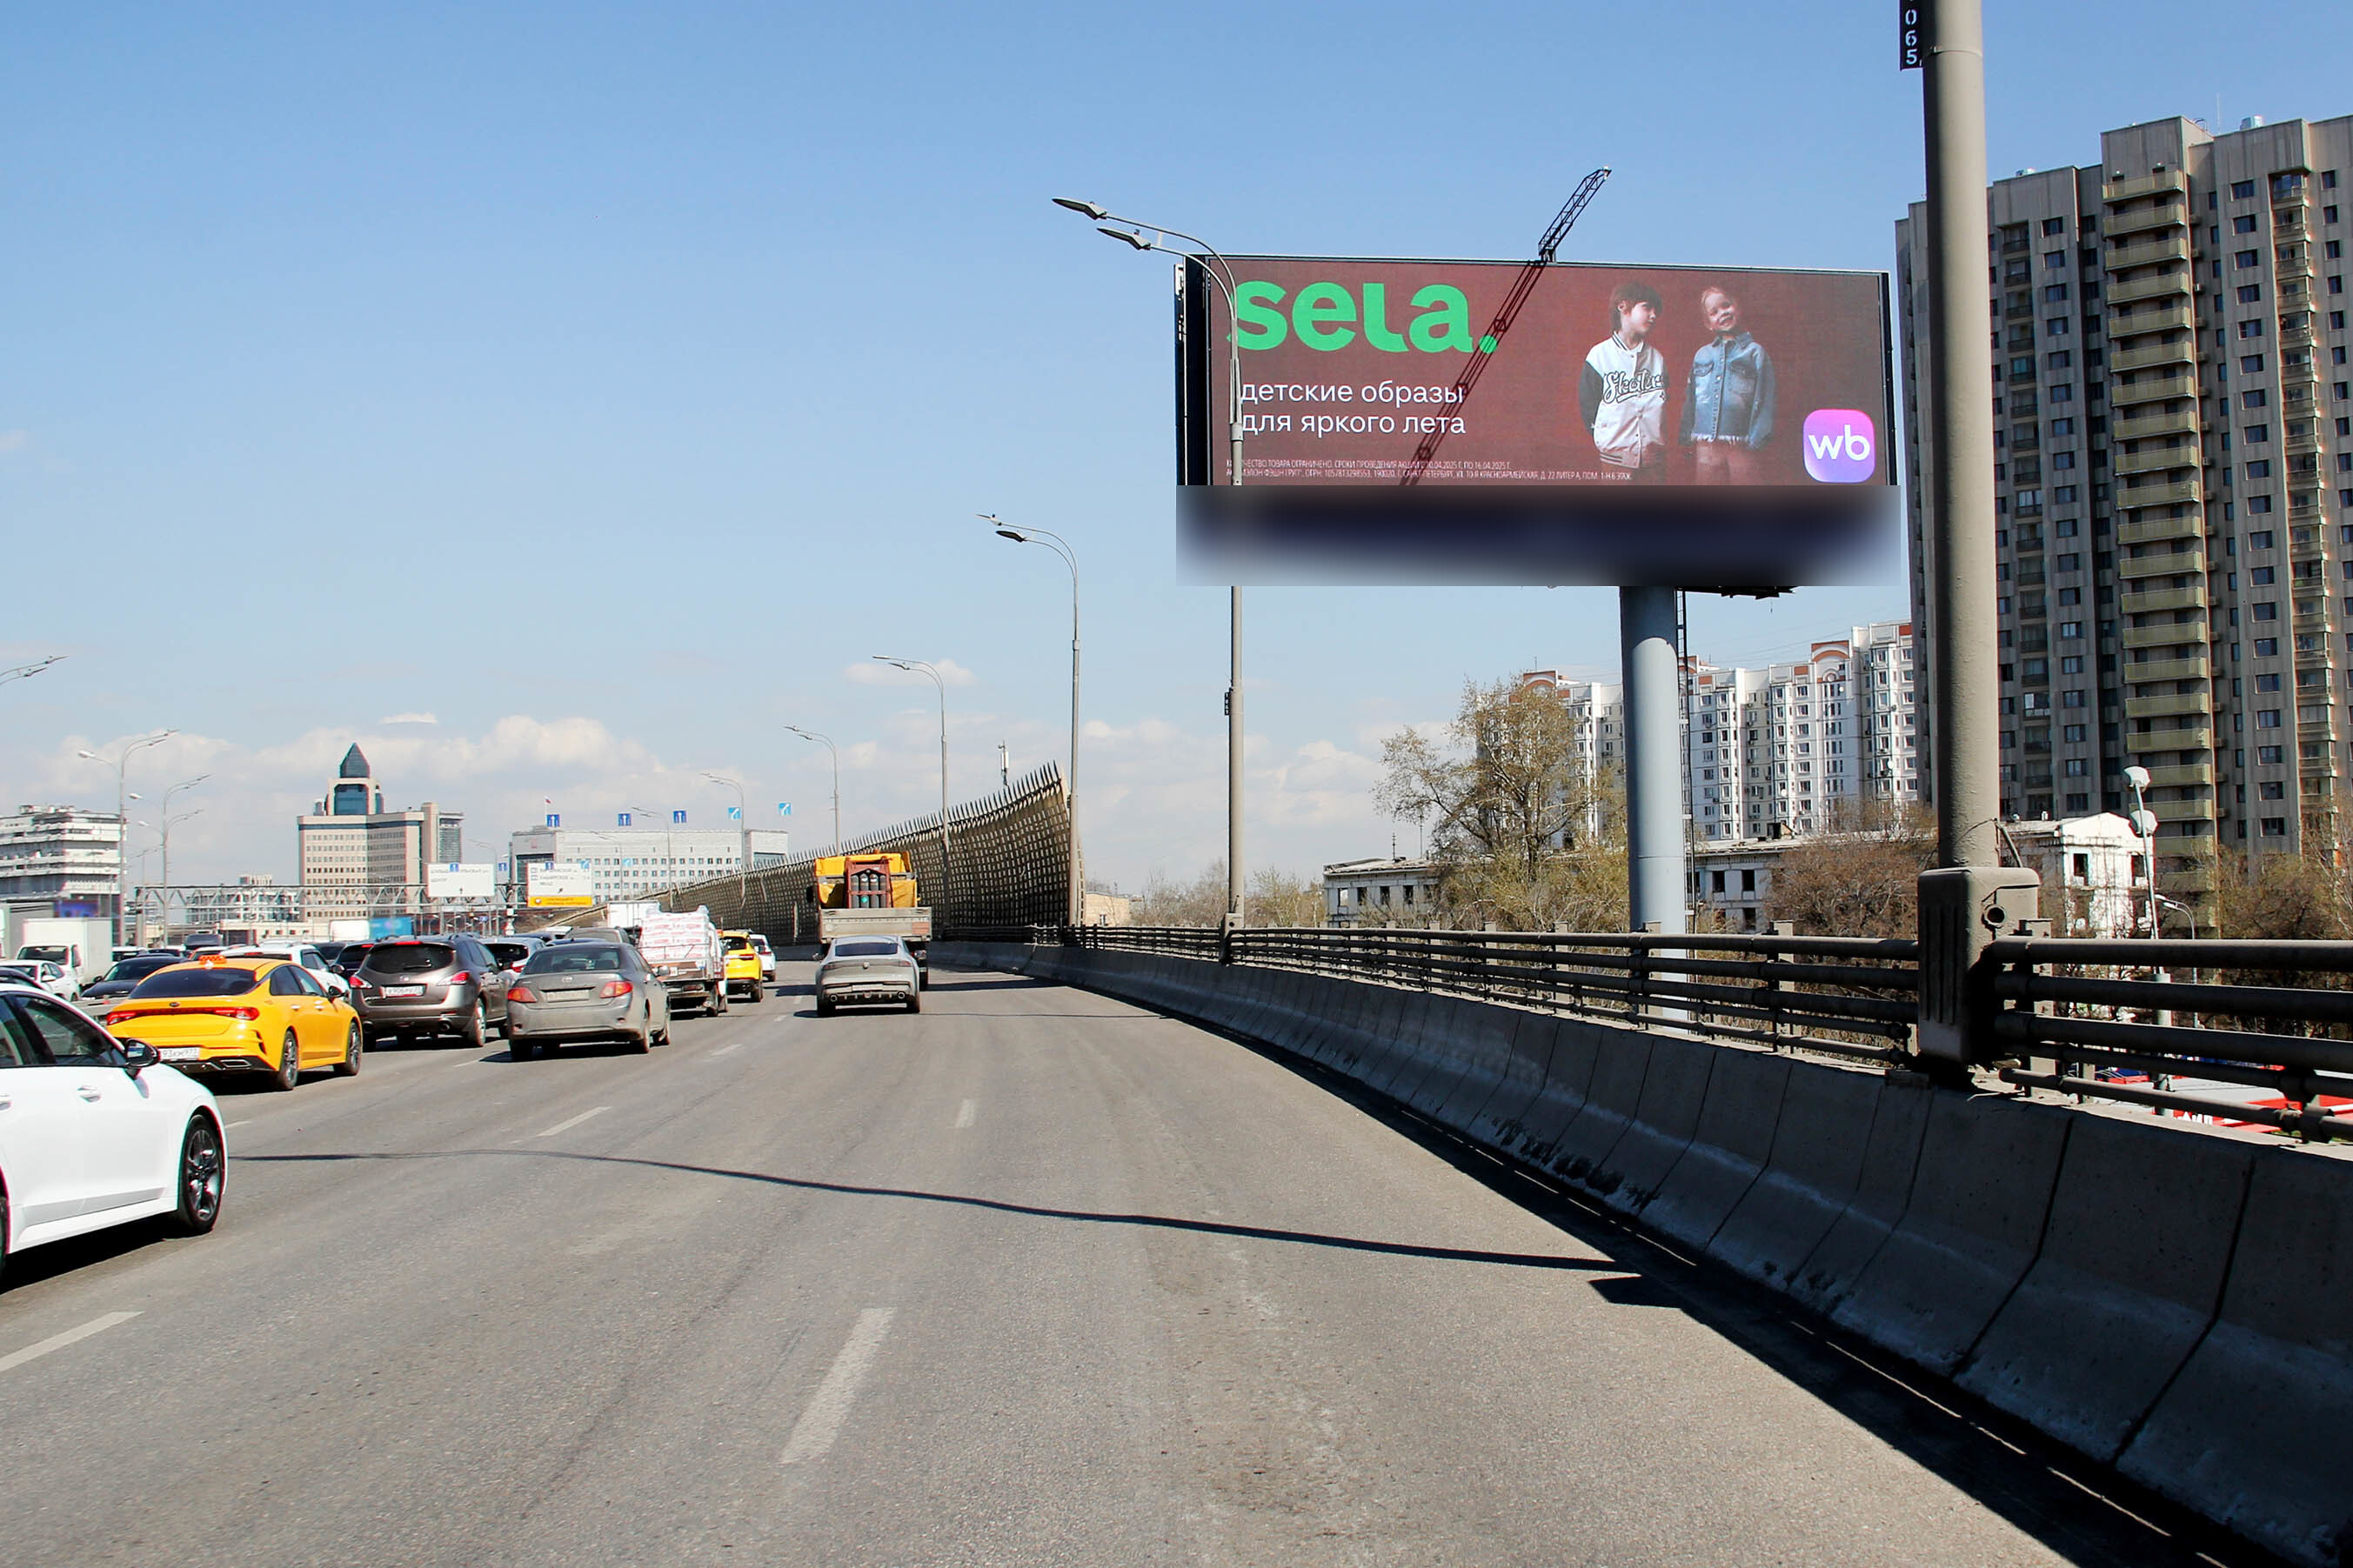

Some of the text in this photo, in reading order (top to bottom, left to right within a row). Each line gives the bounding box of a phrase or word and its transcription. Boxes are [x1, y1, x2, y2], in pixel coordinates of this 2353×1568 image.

[1905, 0, 1917, 65] 065
[1226, 280, 1498, 354] sela.
[1241, 379, 1464, 409] детские образы
[1242, 414, 1467, 438] для яркого лета
[1808, 424, 1870, 461] wb
[1267, 459, 1291, 468] ТОВАРА
